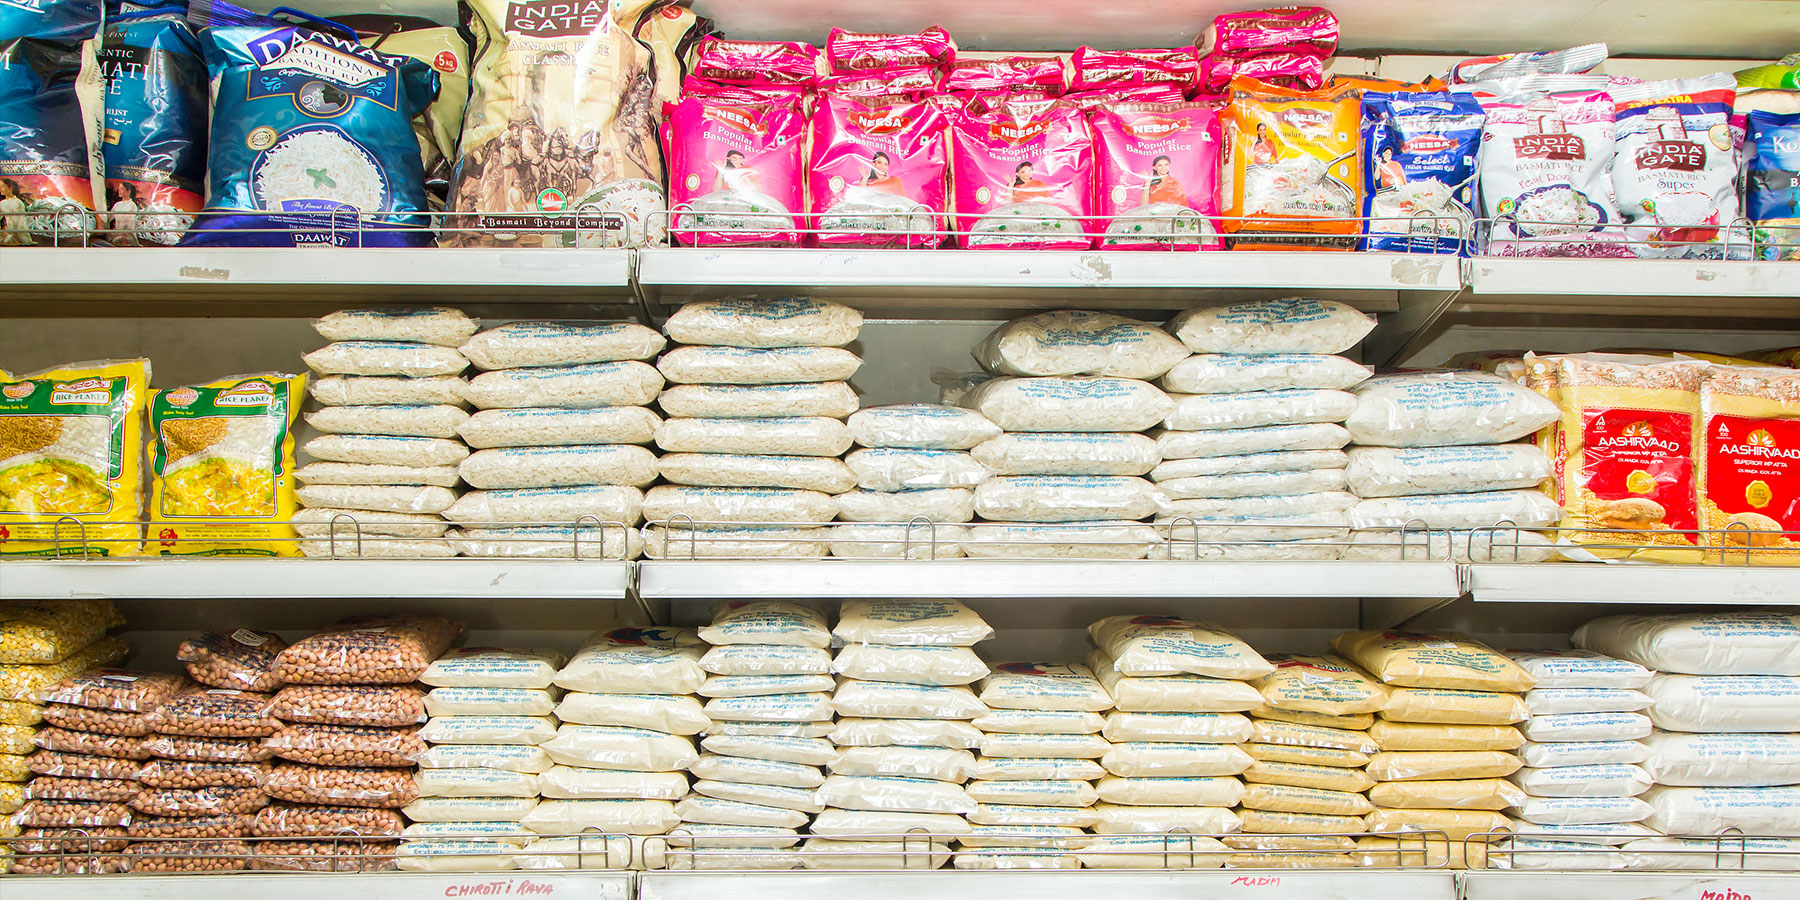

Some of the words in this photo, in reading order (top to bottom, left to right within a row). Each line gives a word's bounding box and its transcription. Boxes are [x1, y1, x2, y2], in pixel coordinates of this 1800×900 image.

[512, 0, 603, 18] INDIA
[514, 14, 599, 32] GATE
[257, 31, 403, 68] DAAWAT
[438, 57, 445, 66] 5
[1655, 95, 1693, 105] EXTRA
[716, 109, 760, 132] NEESA
[858, 115, 903, 128] NEESA
[1001, 123, 1043, 139] NEESA
[1133, 123, 1180, 134] NEESA
[702, 131, 743, 151] Basmati
[717, 125, 754, 146] Popular
[1518, 137, 1580, 146] INDIA
[847, 135, 886, 150] Basmati
[1137, 138, 1176, 151] Popular
[1410, 141, 1453, 151] NEESA
[1001, 142, 1039, 157] Popular
[1126, 143, 1167, 156] Basmati
[1521, 144, 1579, 155] GATE
[1639, 144, 1703, 158] INDIA
[988, 151, 1029, 162] Basmati
[1412, 155, 1450, 166] Select
[1642, 154, 1700, 166] GATE
[1515, 162, 1561, 173] BASMATI
[1637, 171, 1686, 183] BASMATI
[1656, 179, 1695, 191] Super
[486, 217, 527, 227] Basmati
[533, 217, 571, 229] Beyond
[577, 218, 621, 229] Compare
[294, 234, 347, 246] DAAWAT
[1598, 436, 1680, 452] AASHIRVAAD
[1719, 443, 1800, 459] AASHIRVAAD
[1733, 458, 1763, 466] SUPERIOR
[516, 880, 554, 896] RAVA
